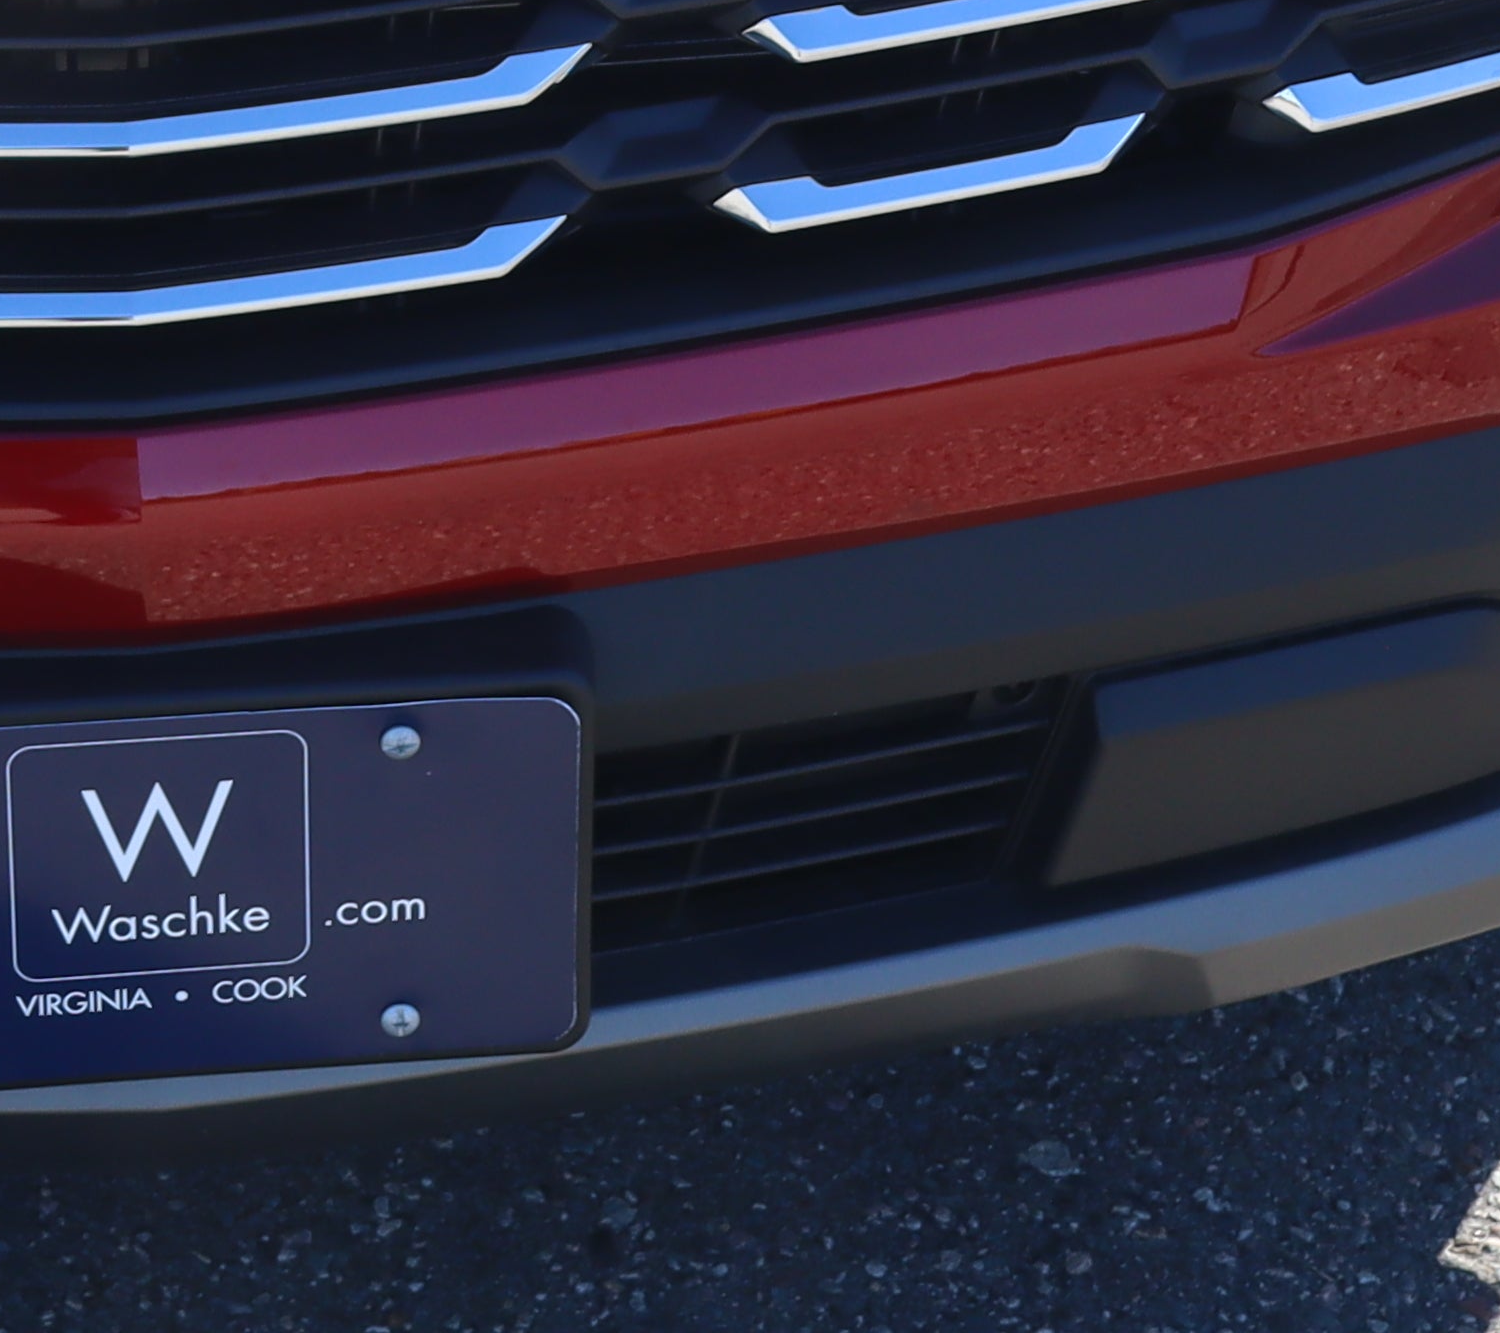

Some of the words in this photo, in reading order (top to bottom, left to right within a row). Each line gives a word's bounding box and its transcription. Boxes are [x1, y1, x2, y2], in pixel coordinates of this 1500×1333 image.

[80, 779, 235, 883] W
[50, 893, 271, 945] Waschke
[324, 893, 427, 927] .com
[14, 986, 153, 1018] VIRGINIA
[211, 973, 308, 1005] COOK
